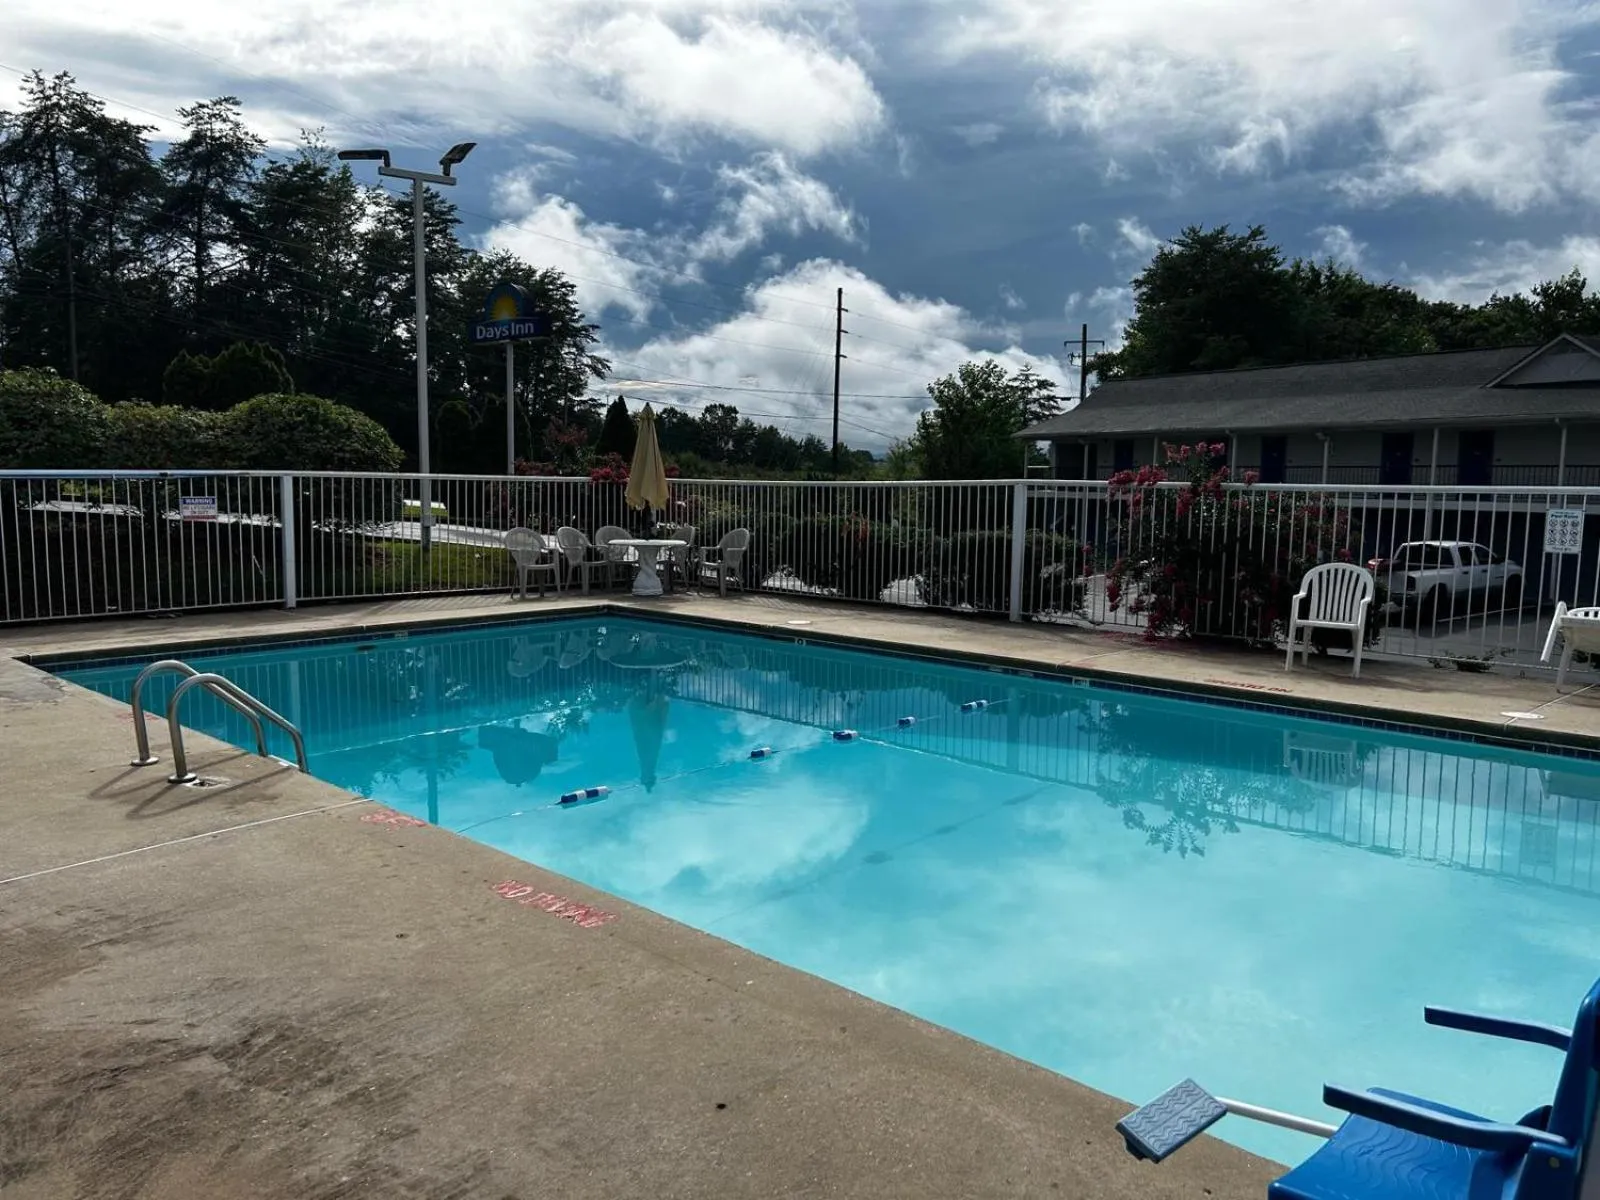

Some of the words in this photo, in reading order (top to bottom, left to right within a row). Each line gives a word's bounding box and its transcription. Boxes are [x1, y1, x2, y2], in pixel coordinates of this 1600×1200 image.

[476, 325, 509, 340] Days
[511, 322, 535, 336] Inn
[492, 880, 534, 898] NO
